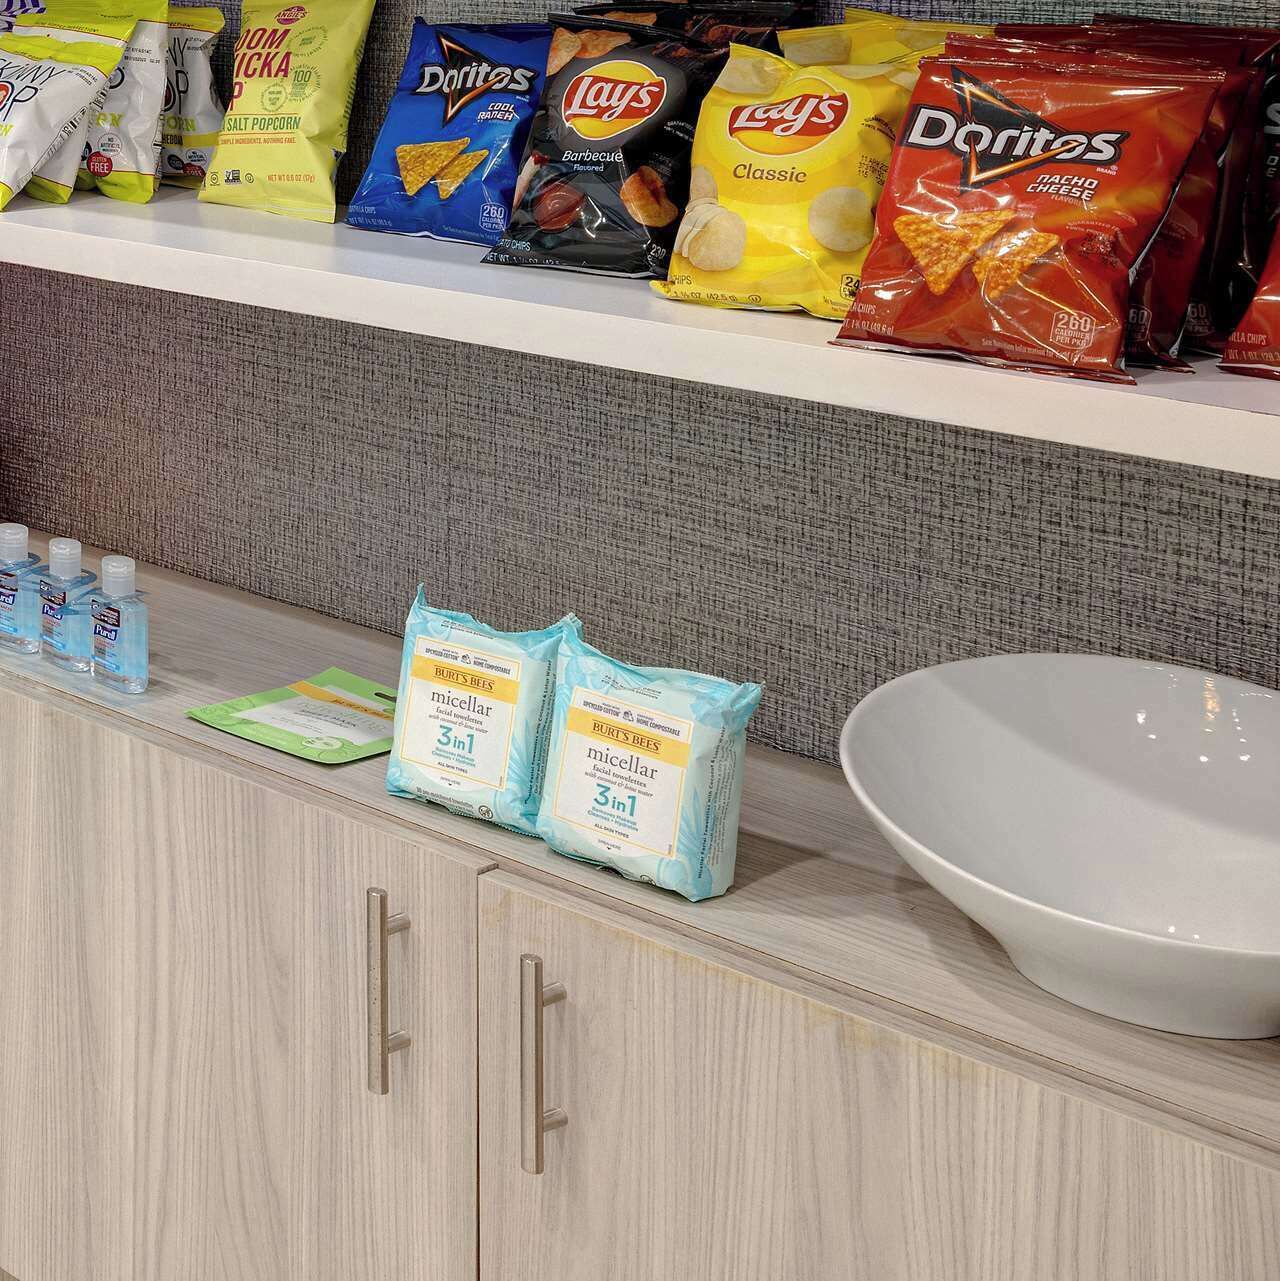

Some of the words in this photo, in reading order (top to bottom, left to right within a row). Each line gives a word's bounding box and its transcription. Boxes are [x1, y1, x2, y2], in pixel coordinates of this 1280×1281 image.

[234, 29, 291, 50] OOM
[234, 52, 292, 78] ICKA
[293, 71, 311, 83] 100
[416, 63, 535, 95] Doritos
[488, 103, 514, 111] COOL
[566, 74, 661, 122] Lay's
[227, 117, 249, 131] SALT
[251, 116, 301, 131] POPCORN
[733, 92, 838, 136] Lay's
[907, 108, 1123, 162] Doritos
[562, 150, 623, 163] Barbecue
[90, 162, 109, 173] FREE
[573, 163, 604, 172] Flavored
[732, 162, 807, 184] Classic
[1026, 182, 1095, 201] CHEESE
[1036, 174, 1099, 189] NACHO
[483, 206, 505, 218] 260
[1055, 312, 1091, 332] 260
[95, 625, 117, 639] Purell
[434, 668, 468, 683] BURT'S
[470, 677, 495, 691] BEES
[431, 690, 493, 717] micellar
[437, 725, 451, 746] 3
[453, 738, 465, 750] in
[467, 734, 474, 753] 1
[593, 721, 629, 741] BURT'S
[632, 733, 661, 751] BEES
[587, 746, 658, 780] micellar
[594, 783, 609, 806] 3
[612, 798, 625, 812] in
[627, 795, 636, 817] 1
